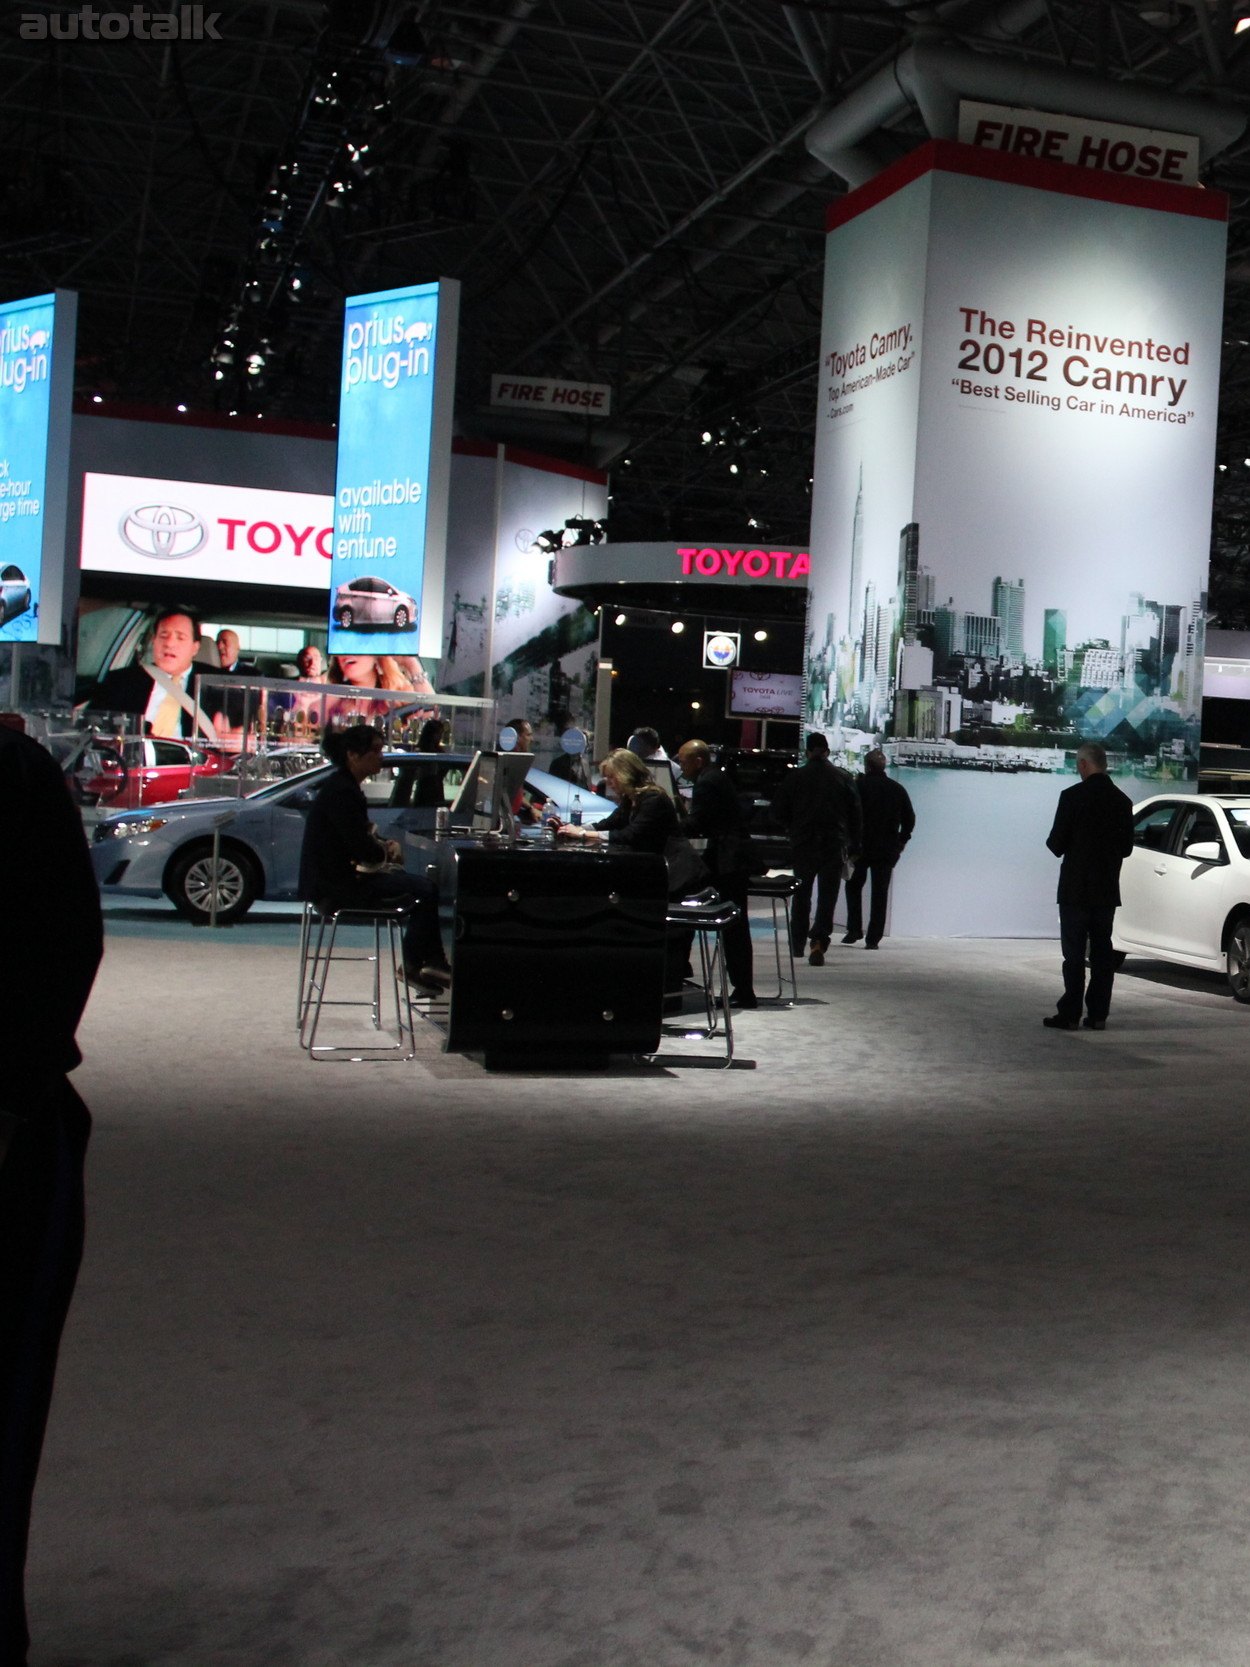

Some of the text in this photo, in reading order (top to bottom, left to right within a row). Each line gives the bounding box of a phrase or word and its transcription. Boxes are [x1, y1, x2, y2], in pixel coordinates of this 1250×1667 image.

[973, 120, 1188, 181] FIRE HOSE
[0, 320, 30, 355] rius
[346, 311, 405, 358] prius
[870, 323, 913, 360] Camry.
[959, 307, 1190, 366] The Reinvented
[0, 348, 47, 393] lug-in
[345, 340, 430, 393] plug-in
[828, 387, 840, 403] Top
[841, 361, 896, 397] American-Made
[957, 339, 1188, 407] 2012 Camry
[498, 382, 605, 408] FIRE HOSE
[1003, 386, 1061, 411] Selling
[1065, 395, 1097, 412] Car
[1100, 400, 1115, 415] in
[0, 480, 32, 497] e-hour
[339, 477, 422, 508] available
[0, 498, 40, 522] rge time
[338, 508, 372, 534] with
[336, 536, 398, 559] entune
[676, 547, 811, 579] TOYOTA
[742, 686, 776, 695] TOYOTA
